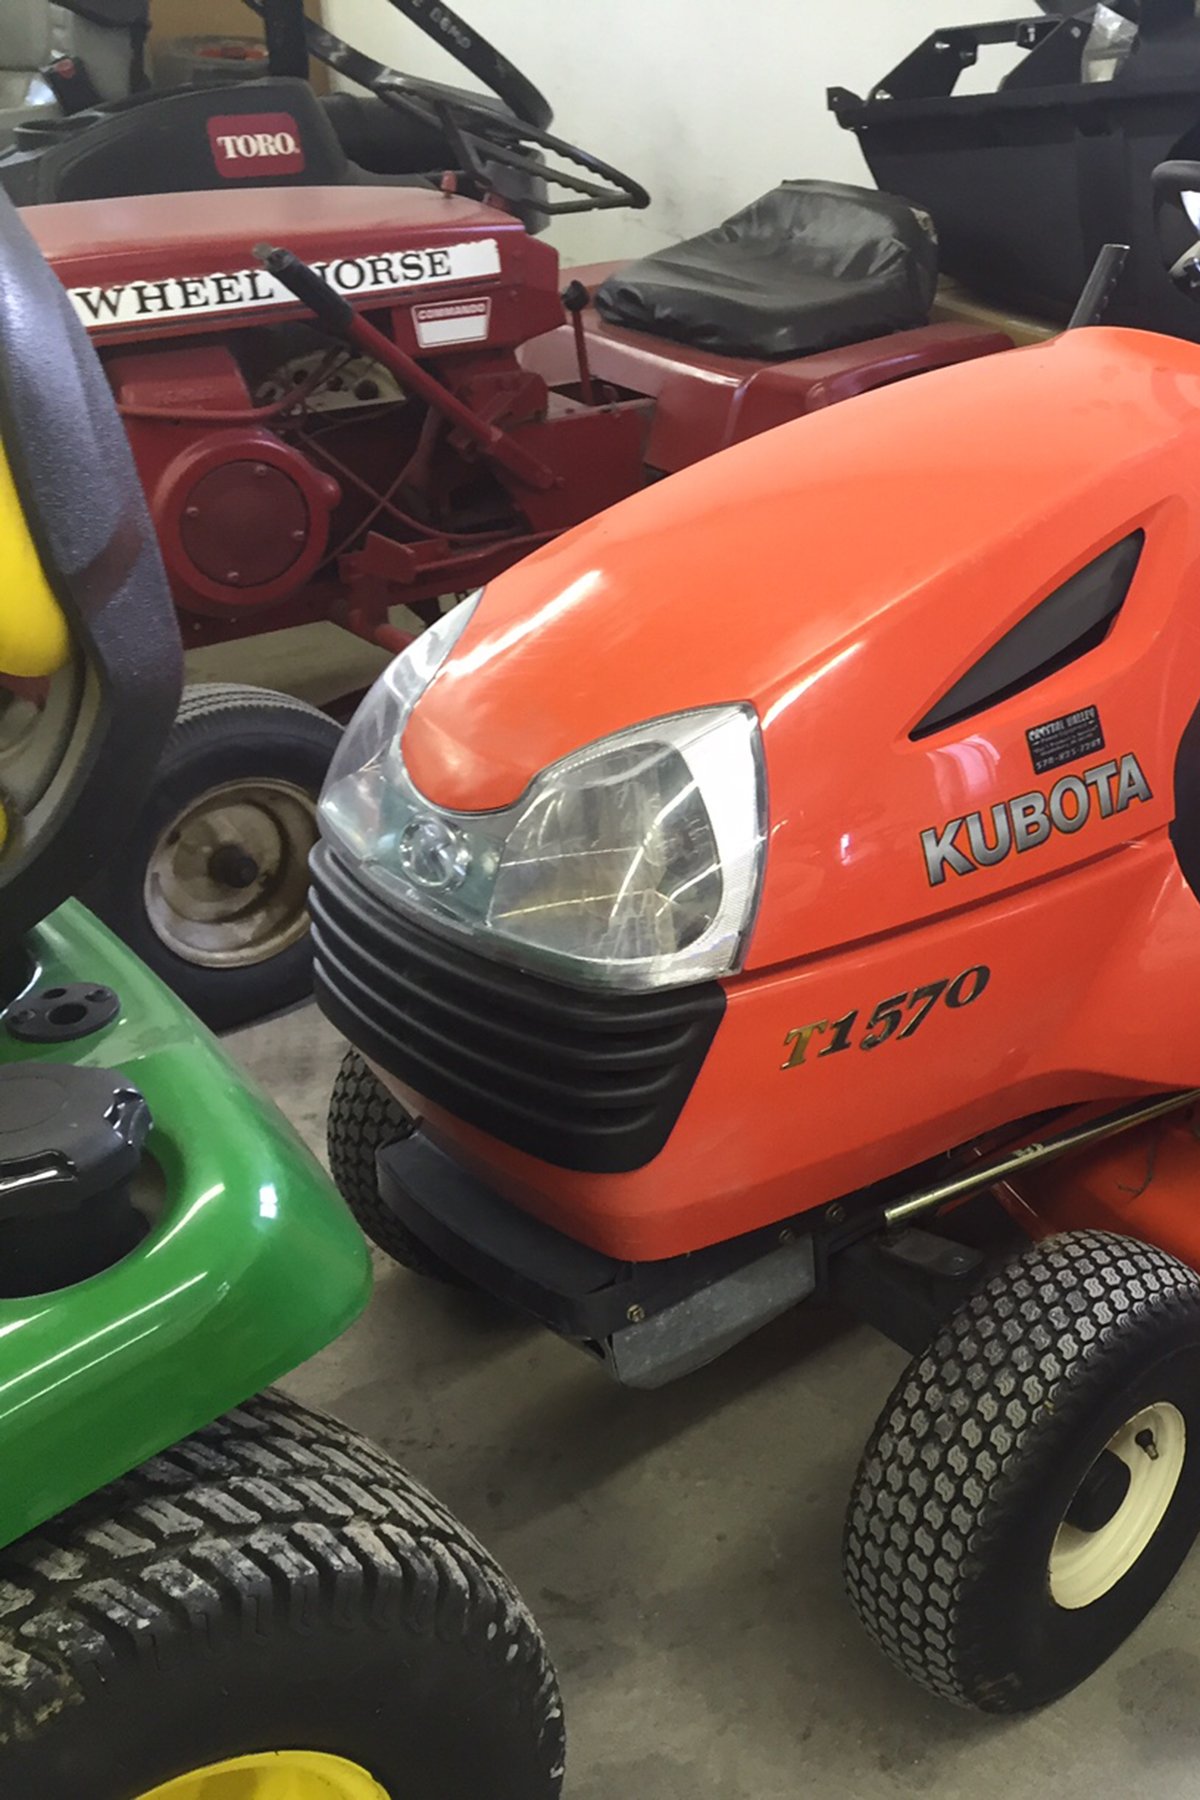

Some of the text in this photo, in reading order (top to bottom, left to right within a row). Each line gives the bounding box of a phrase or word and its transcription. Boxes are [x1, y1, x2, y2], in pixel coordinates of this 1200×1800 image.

[216, 132, 295, 159] TORO
[76, 273, 275, 320] WHEEL
[418, 303, 486, 320] COMMANDO
[920, 752, 1153, 887] KUBOTA
[779, 965, 991, 1070] T1570
